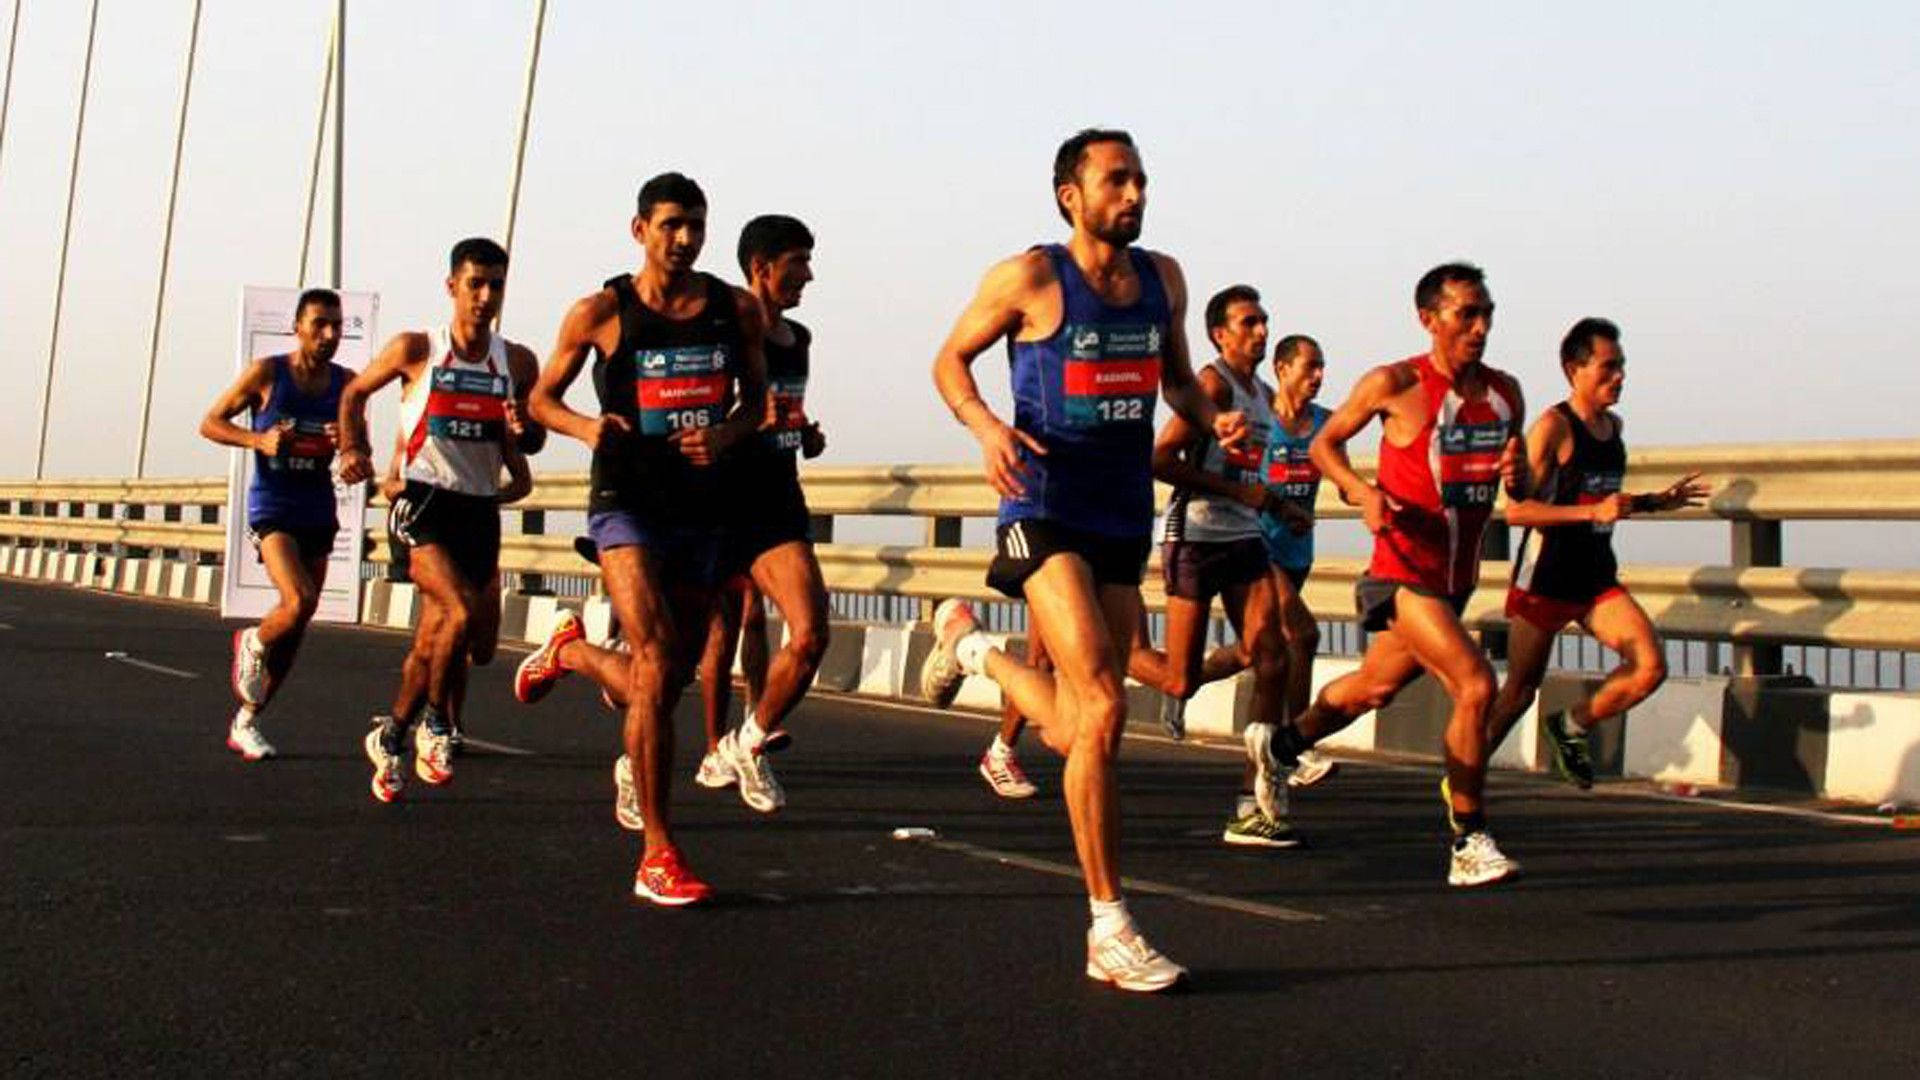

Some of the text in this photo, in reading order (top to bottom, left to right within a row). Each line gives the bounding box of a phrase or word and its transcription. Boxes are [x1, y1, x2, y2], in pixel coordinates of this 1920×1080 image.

[666, 409, 709, 429] 106
[1097, 399, 1143, 420] 122
[448, 420, 482, 437] 121
